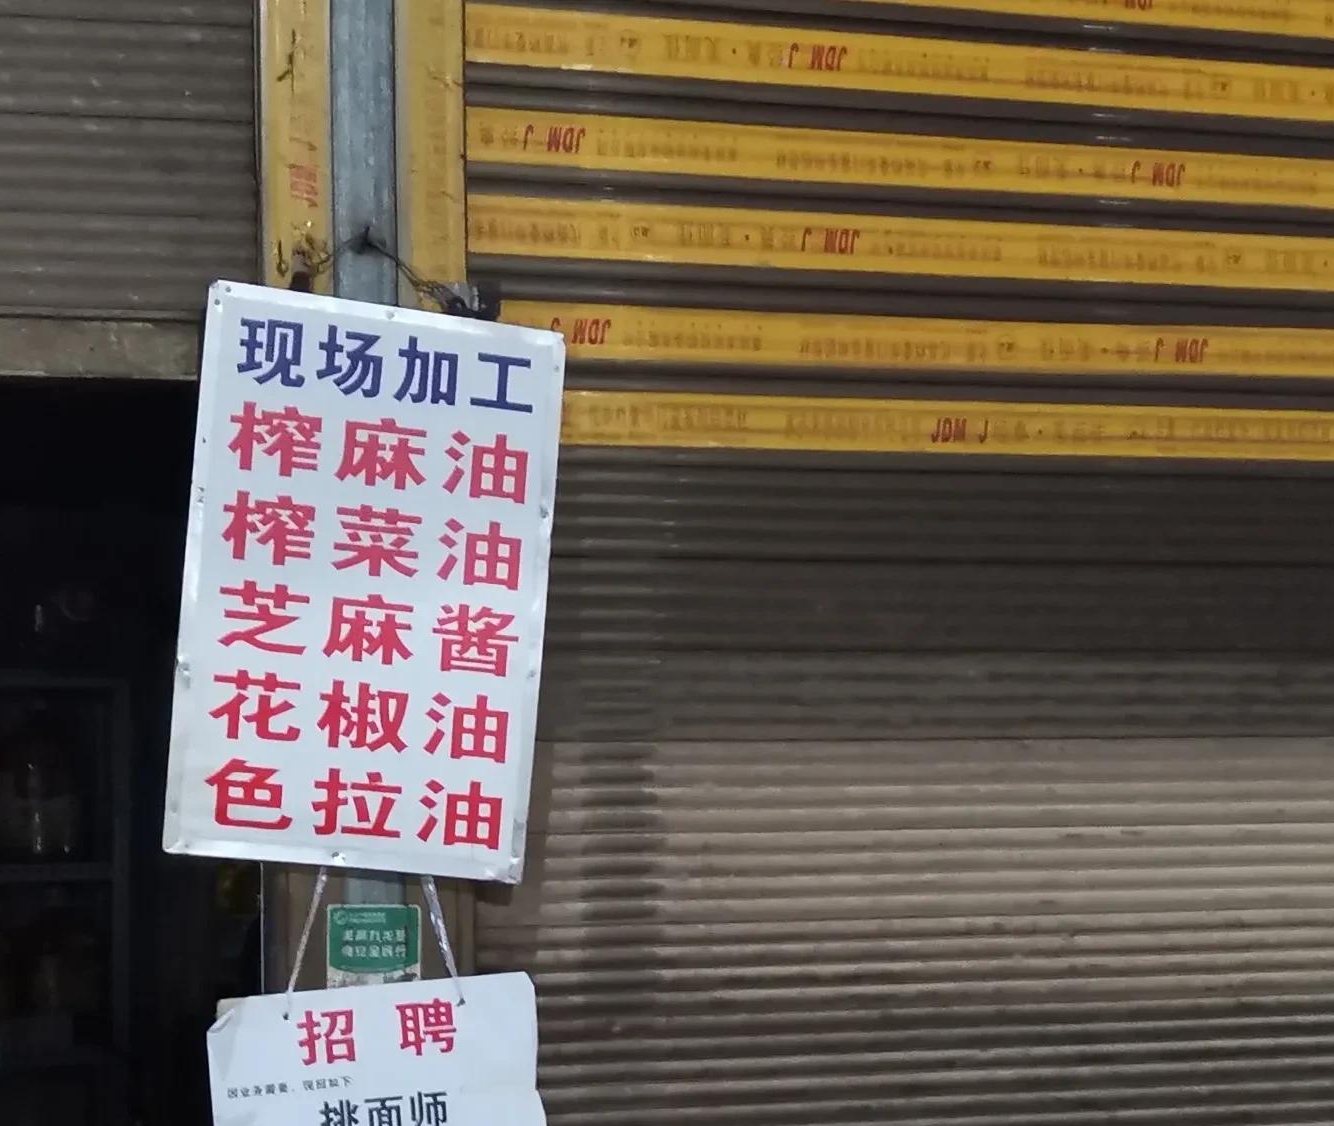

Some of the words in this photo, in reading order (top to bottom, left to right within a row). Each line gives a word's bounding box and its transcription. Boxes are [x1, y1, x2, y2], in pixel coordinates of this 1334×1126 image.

[237, 318, 533, 413] 现场加工
[228, 401, 528, 503] 榨麻油
[222, 491, 523, 591] 榨菜油
[218, 581, 519, 677] 芝麻酱
[209, 669, 510, 764] 花椒油
[205, 759, 504, 850] 色拉油
[297, 998, 457, 1066] 招聘
